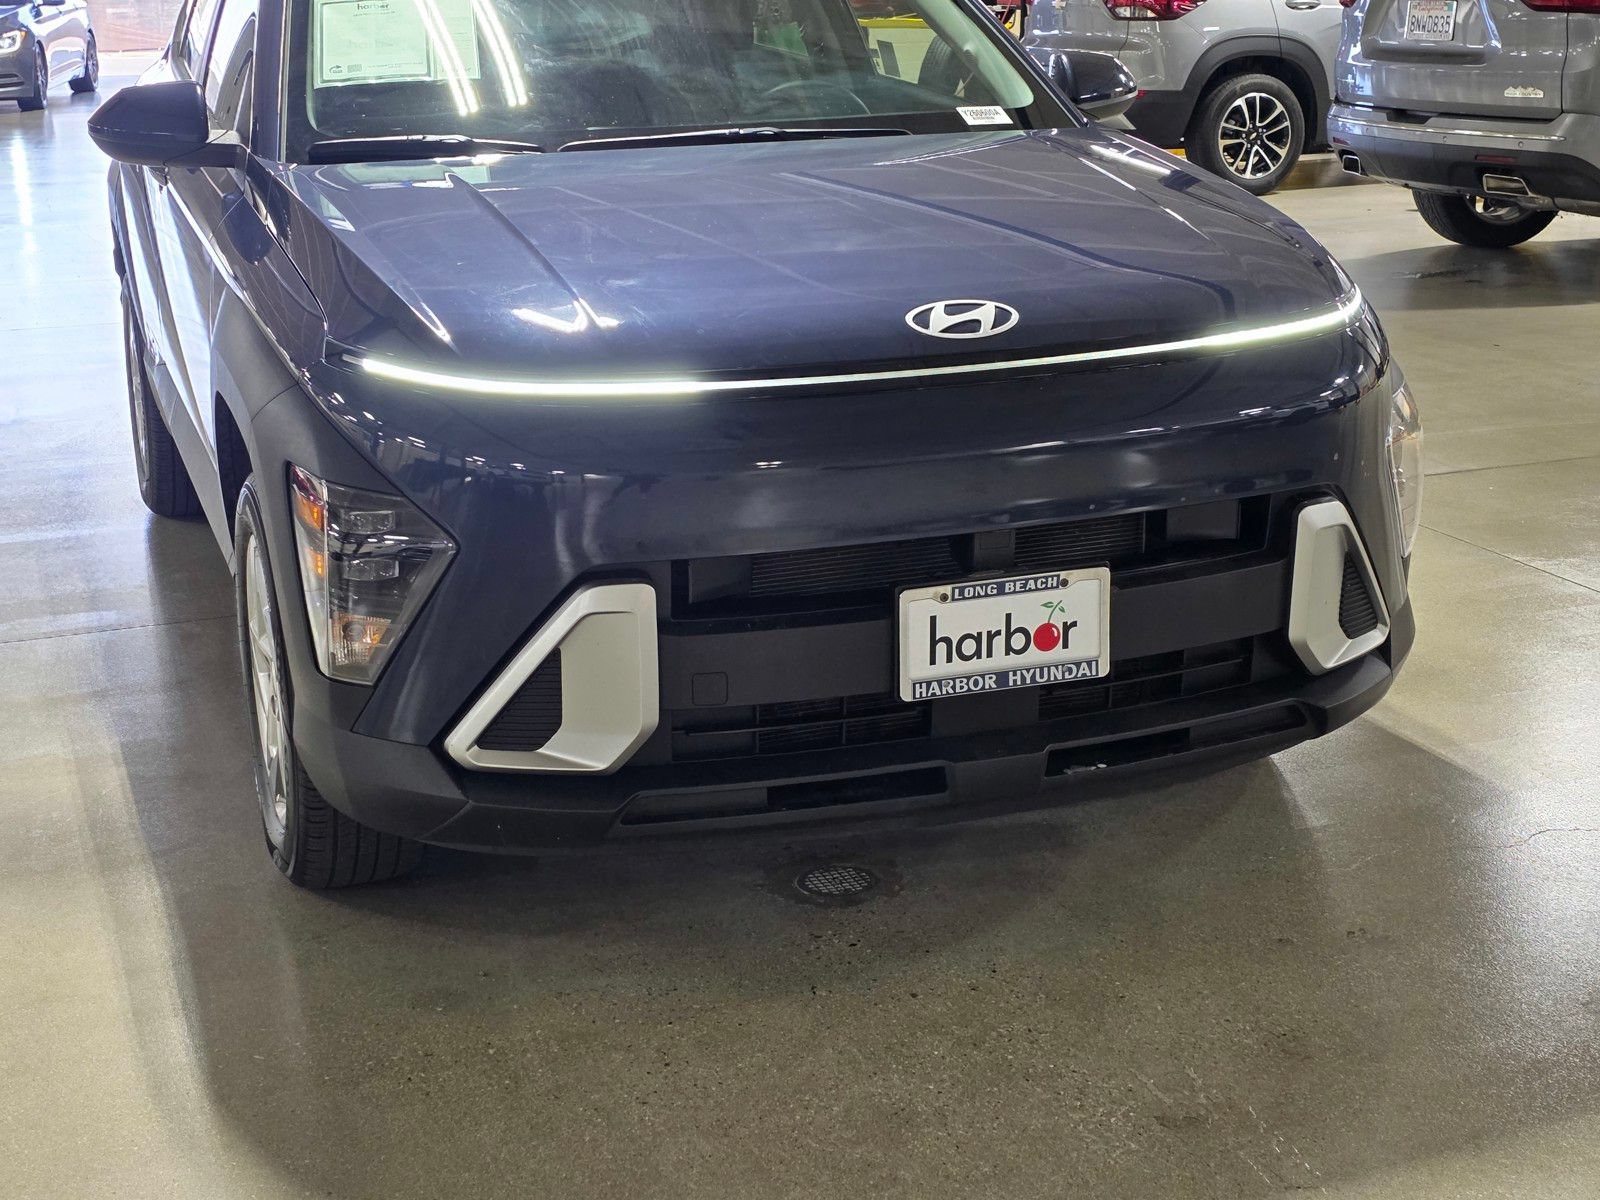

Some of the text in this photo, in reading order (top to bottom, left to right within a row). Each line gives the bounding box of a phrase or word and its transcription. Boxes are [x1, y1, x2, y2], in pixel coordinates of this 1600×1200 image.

[1410, 15, 1450, 33] 8NWD835
[954, 576, 1058, 599] LONG BEACH
[929, 612, 1078, 666] harbor
[915, 660, 1098, 698] HARBOR HYUNDAI
